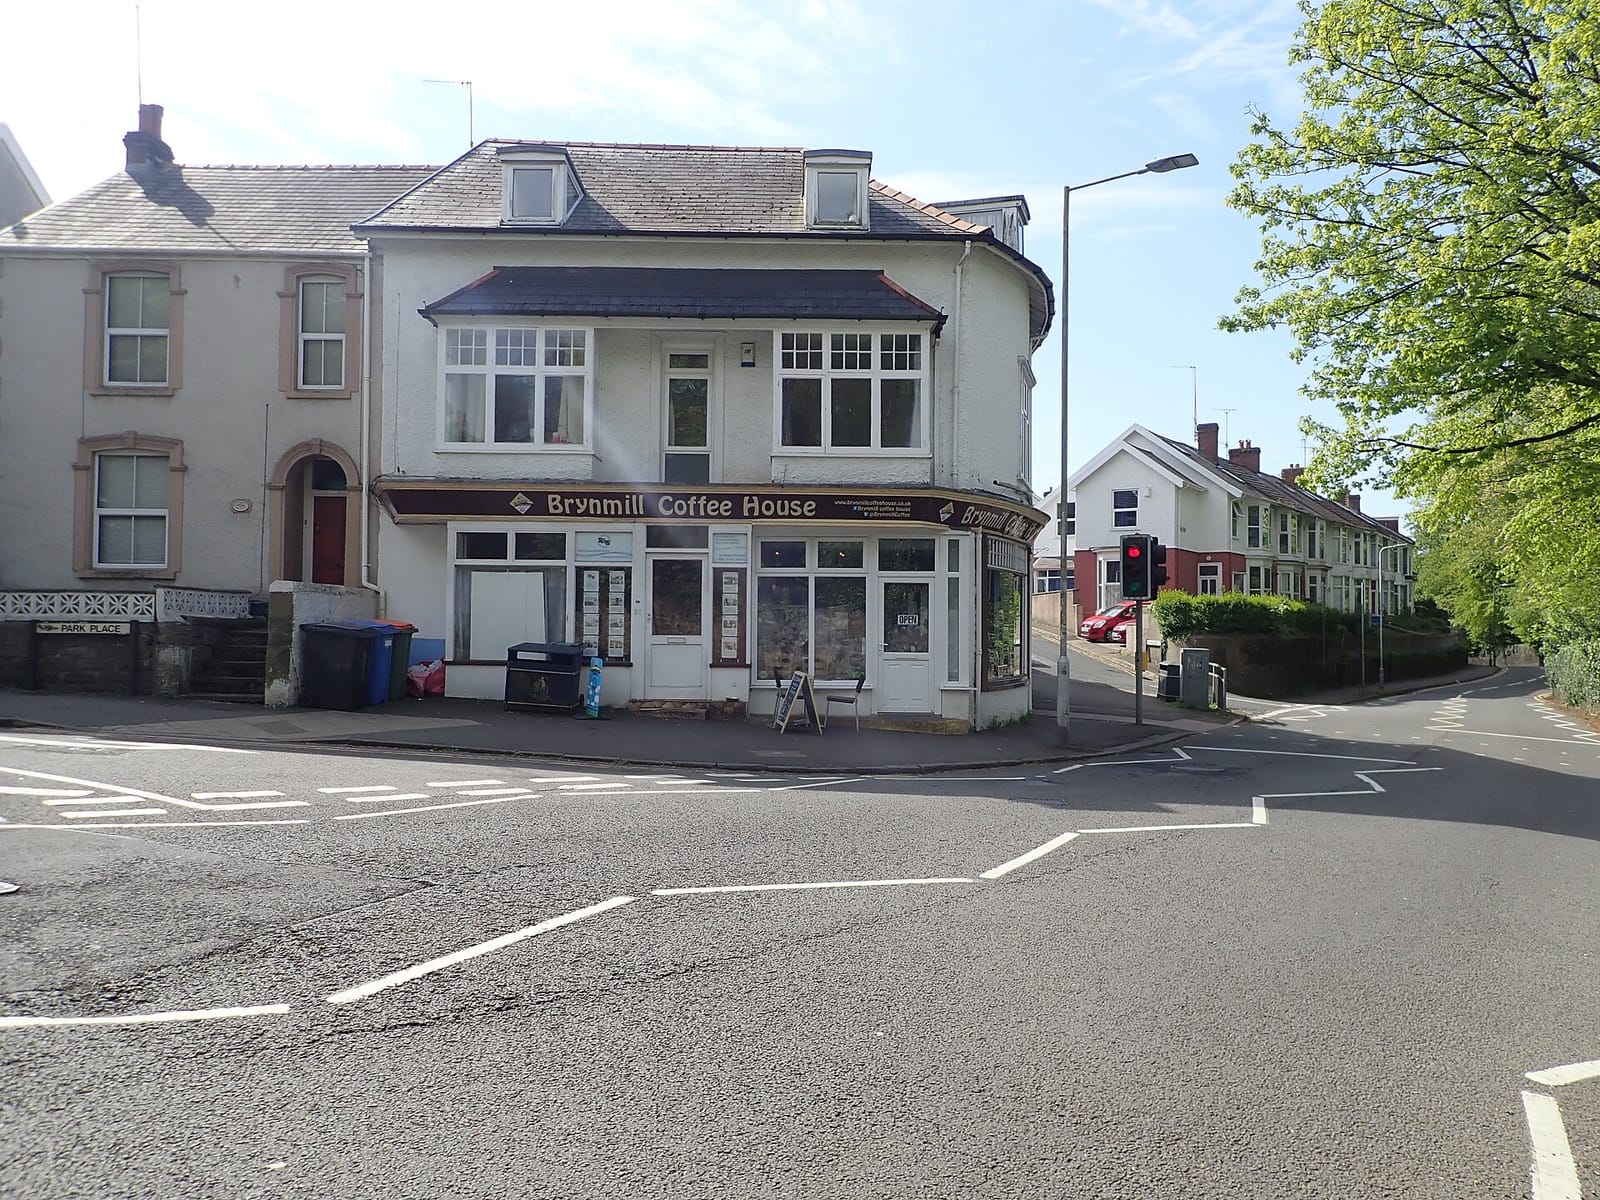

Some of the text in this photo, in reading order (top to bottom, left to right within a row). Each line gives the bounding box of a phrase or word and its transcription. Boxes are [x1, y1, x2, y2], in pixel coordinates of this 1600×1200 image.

[547, 494, 817, 517] Brynmill Coffee House
[961, 506, 1009, 530] Brynmill
[899, 615, 917, 624] OPEN
[61, 624, 121, 633] PARK PLACE
